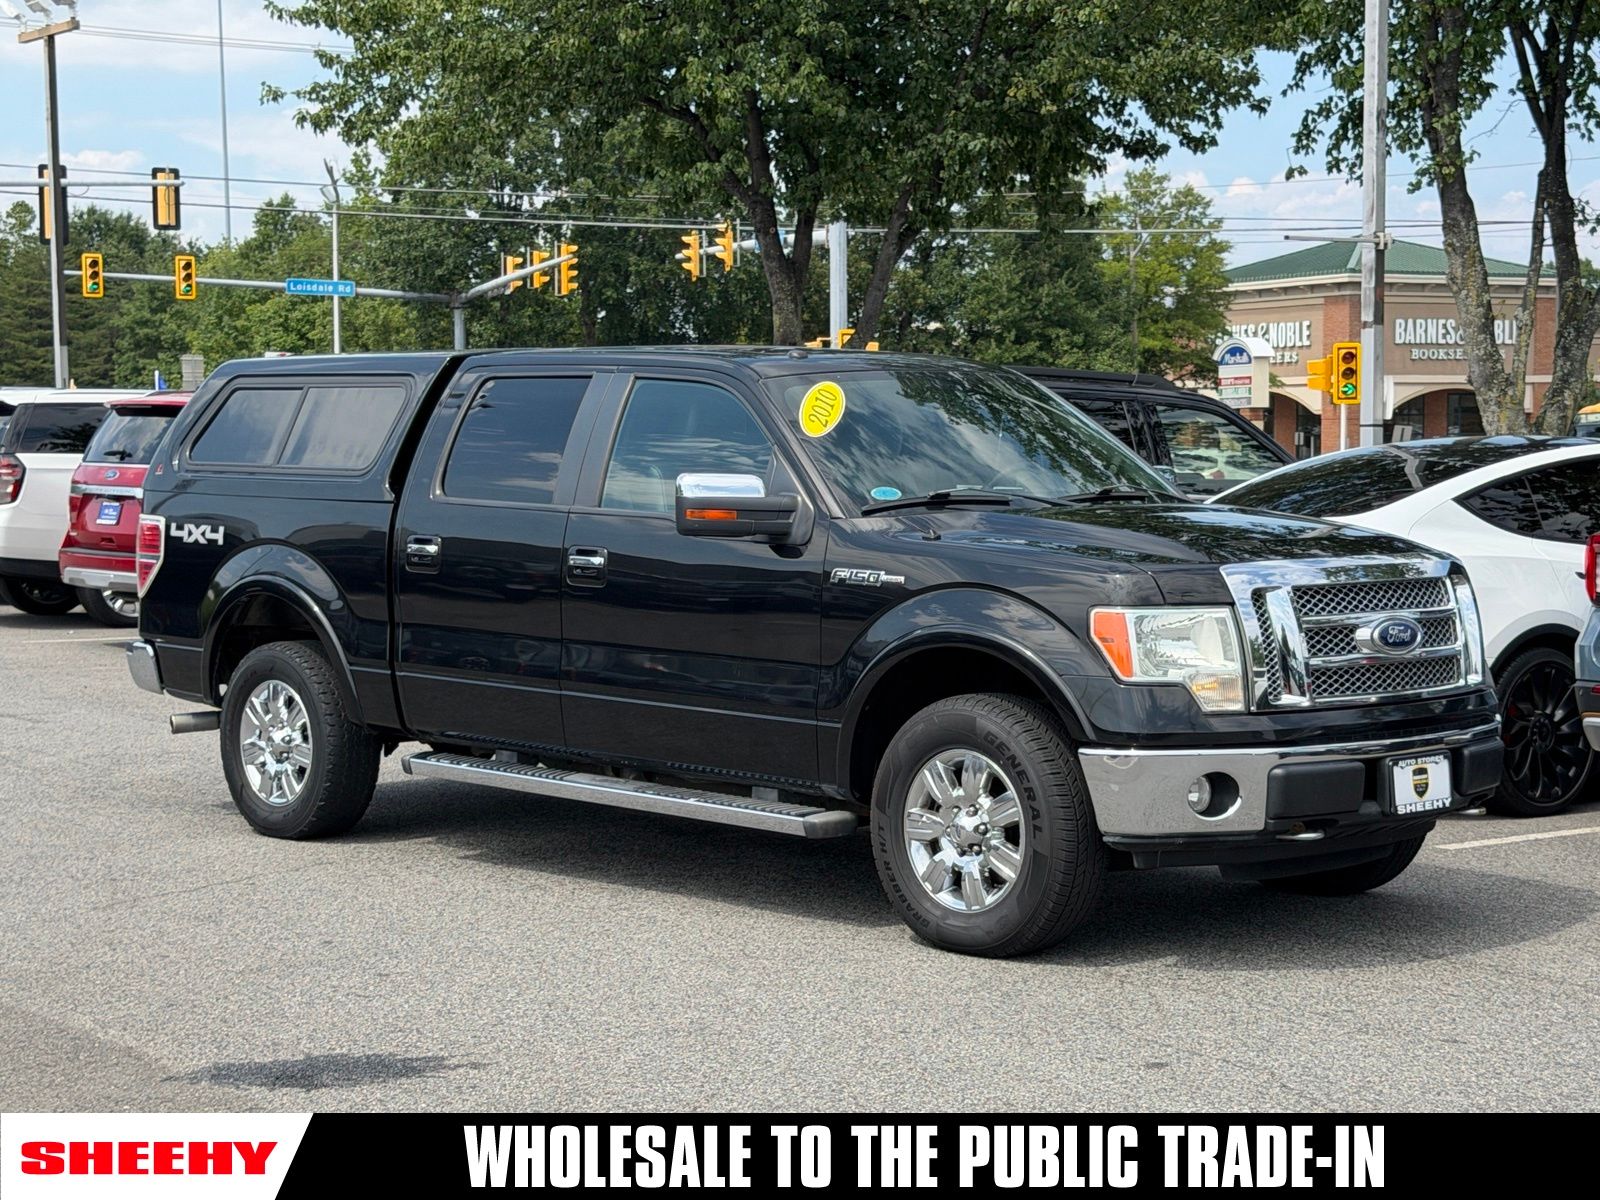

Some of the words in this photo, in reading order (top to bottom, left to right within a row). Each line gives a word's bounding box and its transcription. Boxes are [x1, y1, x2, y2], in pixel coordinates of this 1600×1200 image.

[290, 282, 333, 292] Loisdale
[339, 285, 351, 293] Rd
[1269, 320, 1311, 348] NOBLE
[1395, 318, 1456, 345] BARNES
[808, 388, 837, 428] 2010
[1387, 625, 1412, 644] Ford
[1398, 758, 1417, 767] AUTO
[983, 730, 1043, 840] GENERAL
[1397, 797, 1452, 815] SHEEHY
[883, 860, 931, 929] GRABBER
